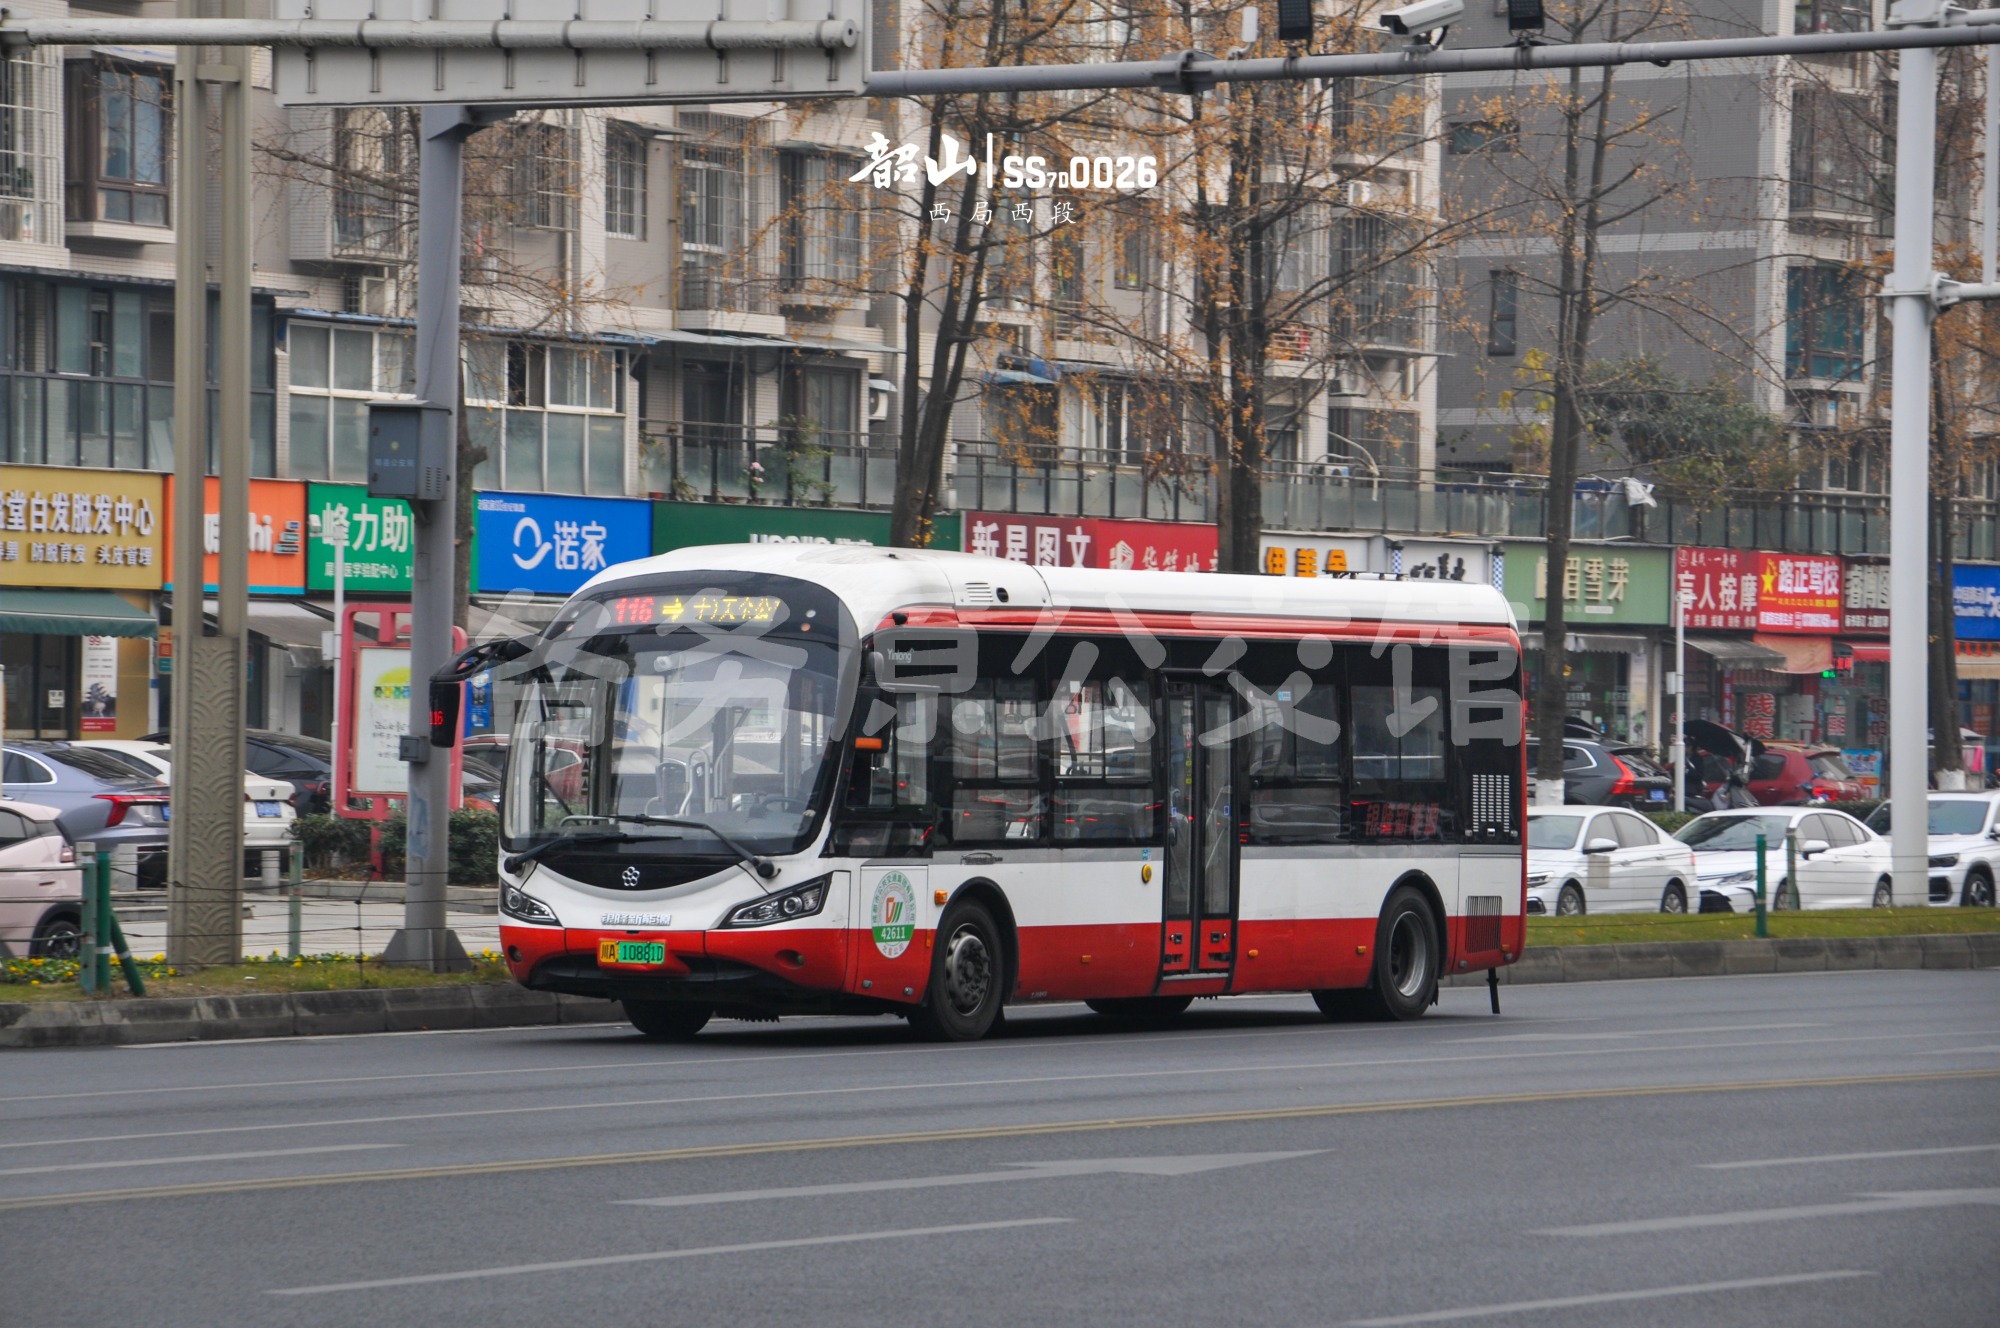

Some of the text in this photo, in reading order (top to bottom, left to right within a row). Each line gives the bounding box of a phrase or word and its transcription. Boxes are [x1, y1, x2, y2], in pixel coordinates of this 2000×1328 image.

[0, 489, 155, 536] 堂白发脱发中心
[321, 502, 415, 553] 峰力助
[552, 519, 607, 571] 诺家
[972, 520, 1091, 568] 新星图文
[615, 597, 655, 624] 116
[1677, 570, 1758, 612] 盲人按摩
[1744, 692, 1777, 738] 残疾
[601, 912, 672, 926] 银隆新能源
[881, 926, 906, 940] 42611
